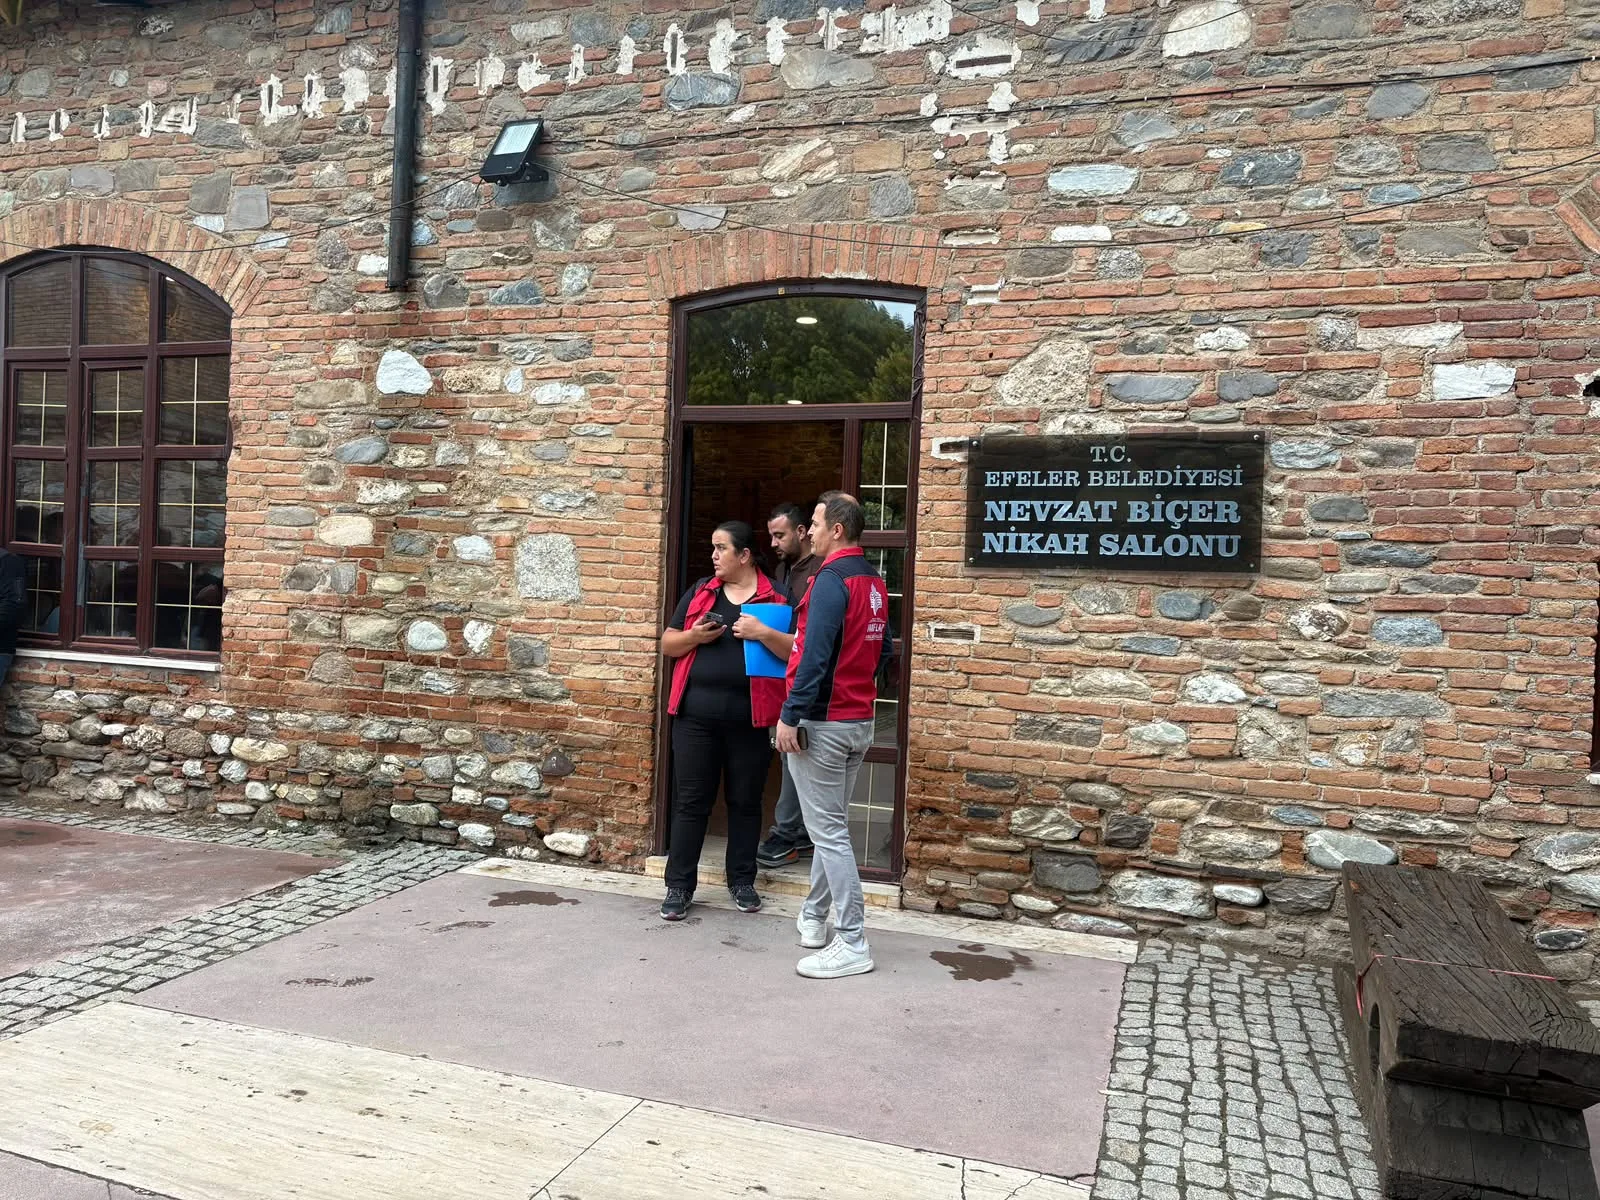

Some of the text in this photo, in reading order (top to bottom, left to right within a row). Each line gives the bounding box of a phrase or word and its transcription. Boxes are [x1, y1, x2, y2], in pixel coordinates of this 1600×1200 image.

[1090, 445, 1131, 462] T.C.
[984, 465, 1243, 487] EFELER BELEDİYESİ
[984, 494, 1241, 529] NEVZAT BİÇER
[982, 526, 1241, 557] NİKAH SALONU
